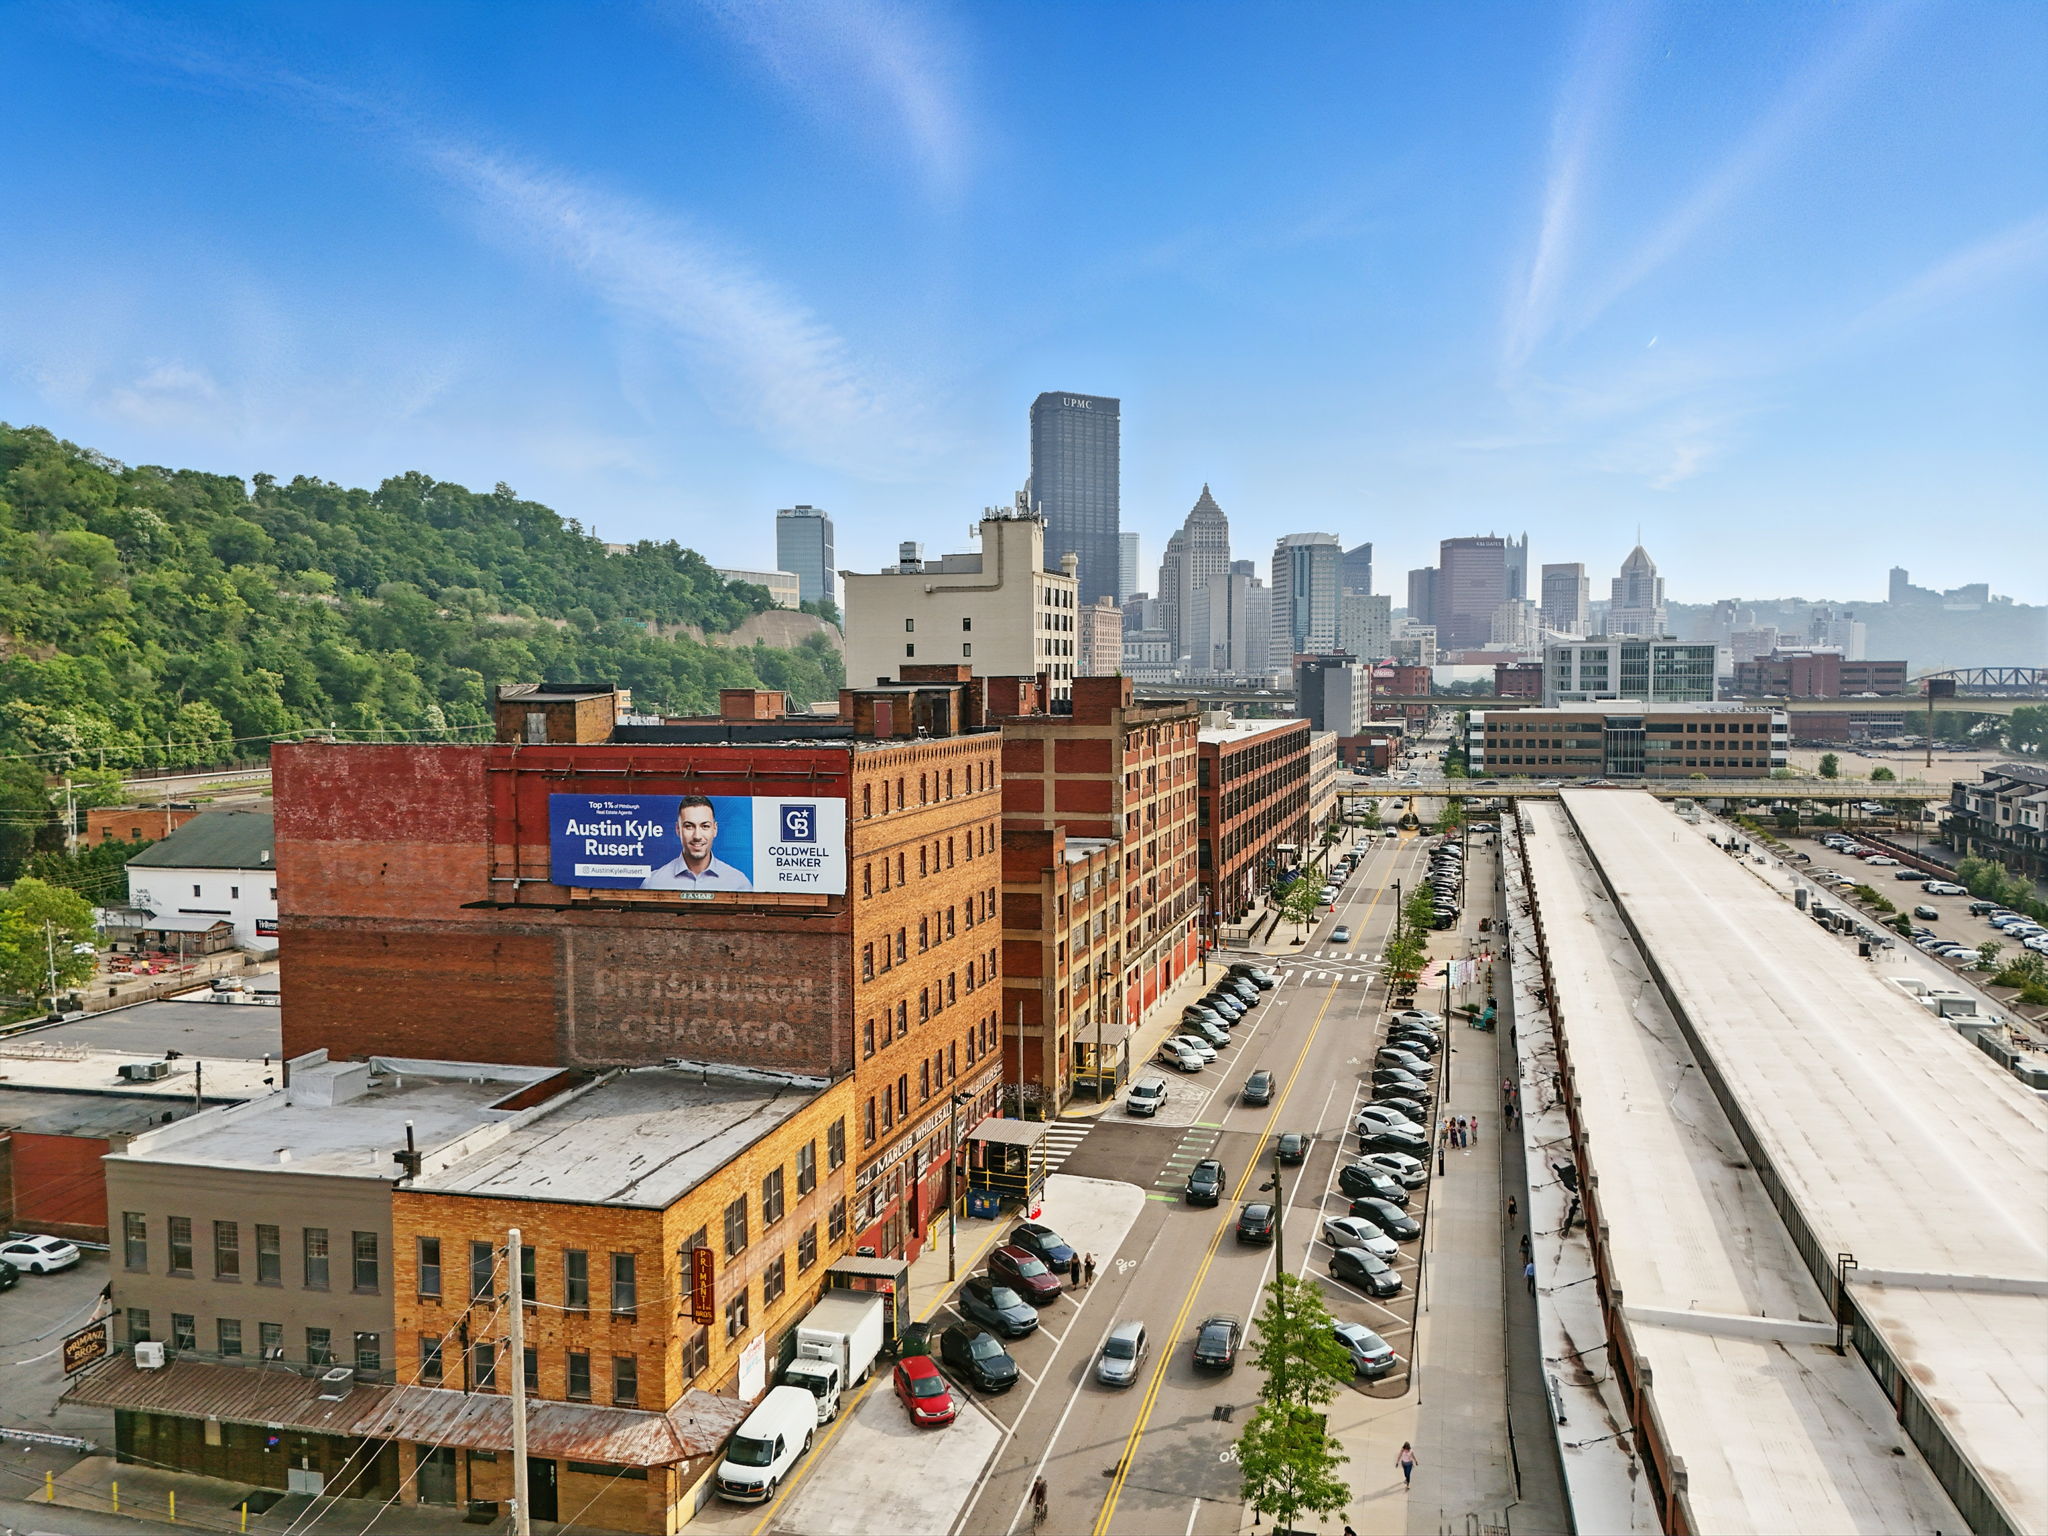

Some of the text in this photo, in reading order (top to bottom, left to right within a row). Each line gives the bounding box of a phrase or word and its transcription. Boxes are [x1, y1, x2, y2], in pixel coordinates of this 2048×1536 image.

[1063, 397, 1092, 409] UPMC
[588, 801, 602, 809] Top
[603, 801, 613, 809] 1%
[565, 819, 663, 840] Austin Kyle
[585, 839, 644, 856] Rusert
[768, 847, 829, 857] COLDWELL
[776, 857, 821, 867] BANKER
[779, 872, 819, 882] REALTY
[876, 1134, 913, 1175] MARCUS
[700, 1250, 708, 1311] PRIMANTI
[66, 1331, 104, 1355] PRIMANTI
